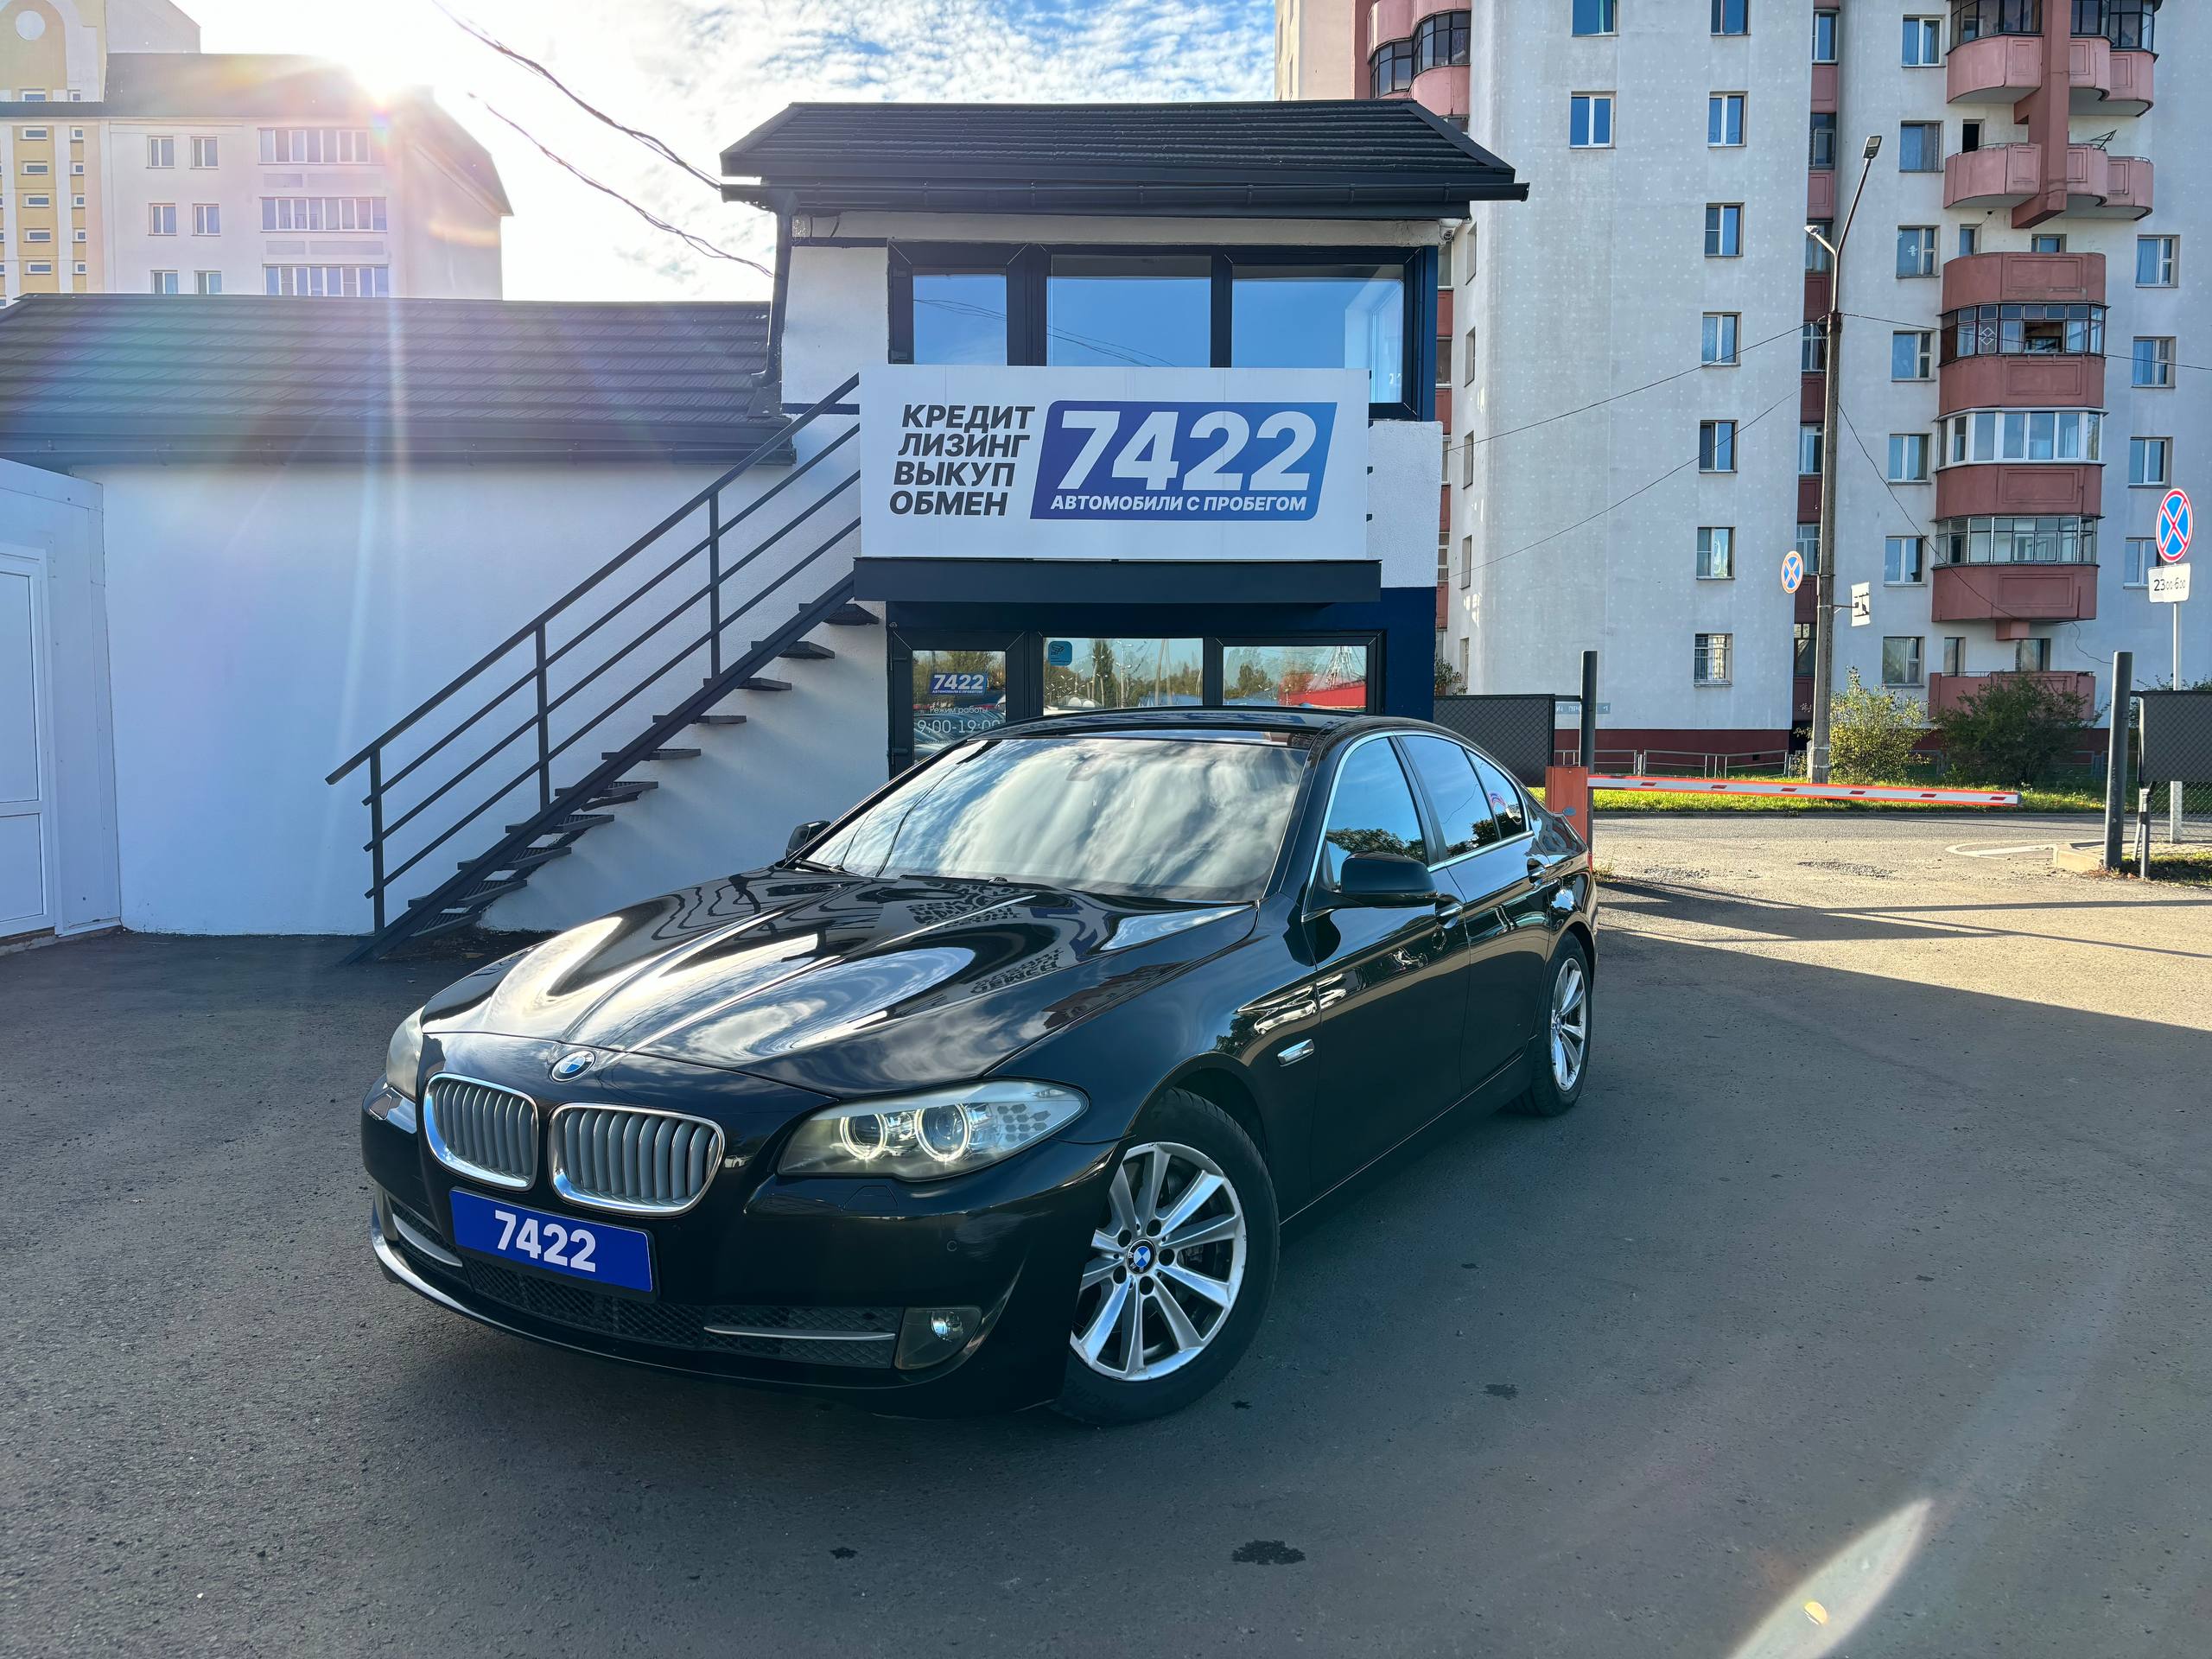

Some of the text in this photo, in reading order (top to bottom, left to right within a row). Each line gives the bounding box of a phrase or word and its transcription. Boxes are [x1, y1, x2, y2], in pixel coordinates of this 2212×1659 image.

[901, 404, 1035, 434] КРЕДИТ
[898, 433, 1031, 458] ЛИЗИНГ
[1057, 410, 1317, 491] 7422
[893, 461, 1016, 487] ВЫКУП
[889, 490, 1008, 516] ОБМЕН
[1051, 495, 1307, 512] АВТОМОБИЛИ С ПРОБЕГОМ
[933, 674, 984, 690] 7422
[958, 705, 988, 715] работы
[494, 1210, 596, 1273] 7422
